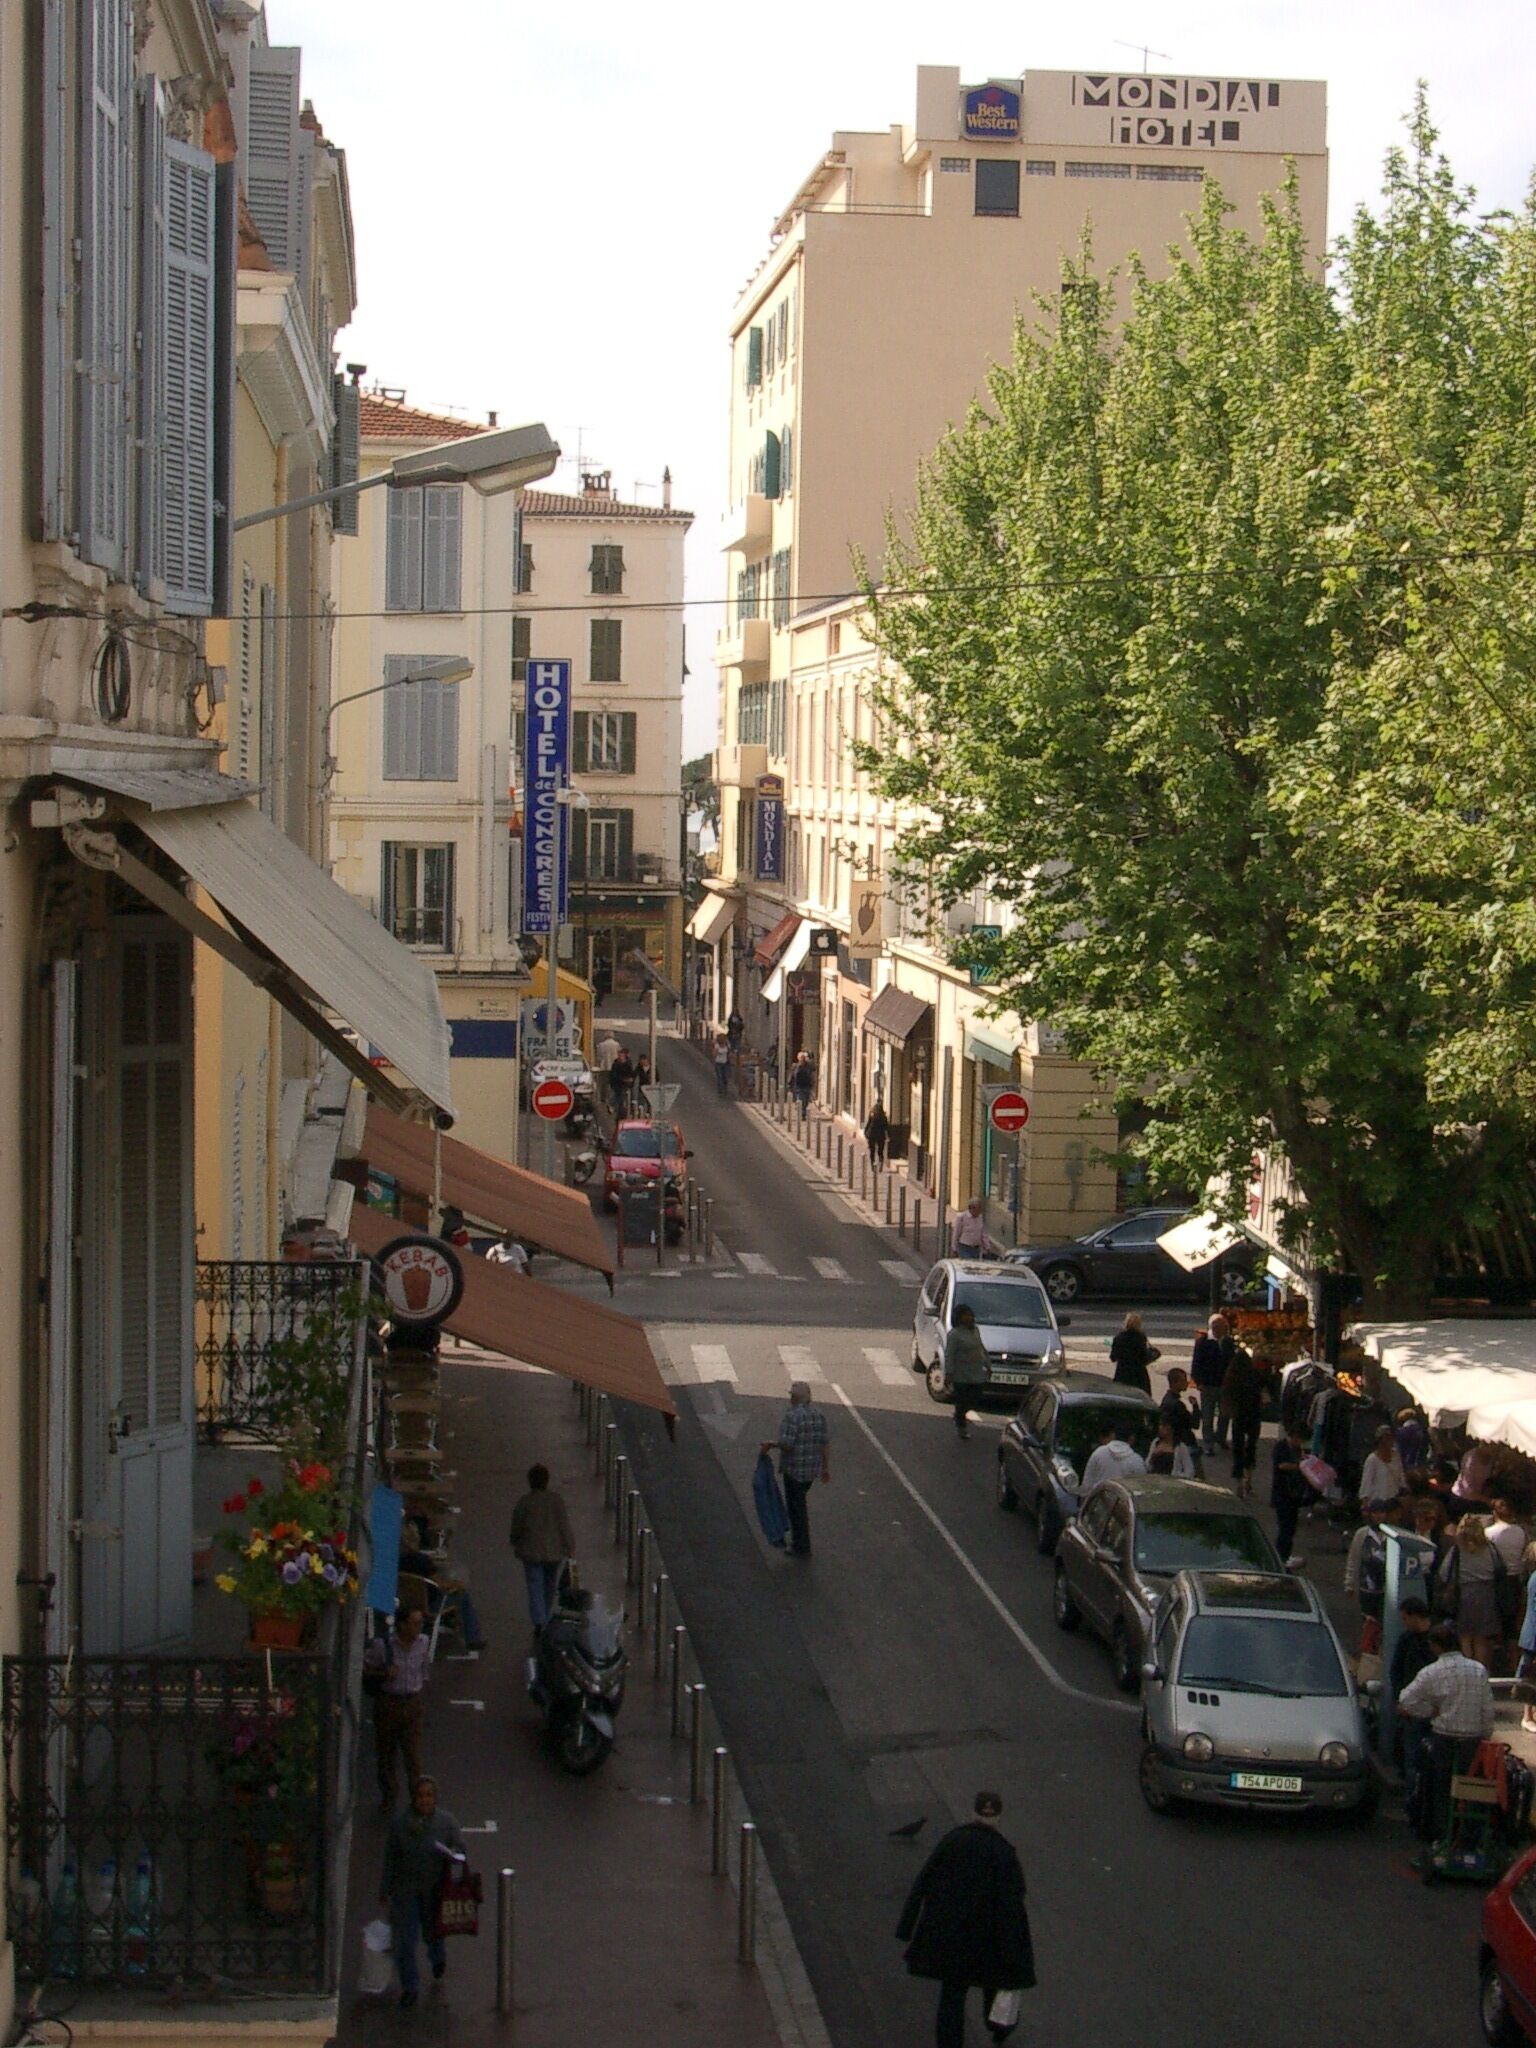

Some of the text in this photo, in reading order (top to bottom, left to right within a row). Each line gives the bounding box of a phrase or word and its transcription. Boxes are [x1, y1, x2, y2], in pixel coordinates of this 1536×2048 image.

[1072, 75, 1280, 113] MONDIAL
[966, 113, 1018, 130] Western
[977, 103, 1006, 118] Best
[1111, 116, 1239, 147] HOTEL
[534, 664, 561, 777] HOTEL
[762, 801, 776, 871] MONDIAL
[527, 1037, 569, 1047] FRACE
[385, 1249, 448, 1277] KEBAB
[1406, 1557, 1418, 1575] P
[1241, 1775, 1261, 1787] 754
